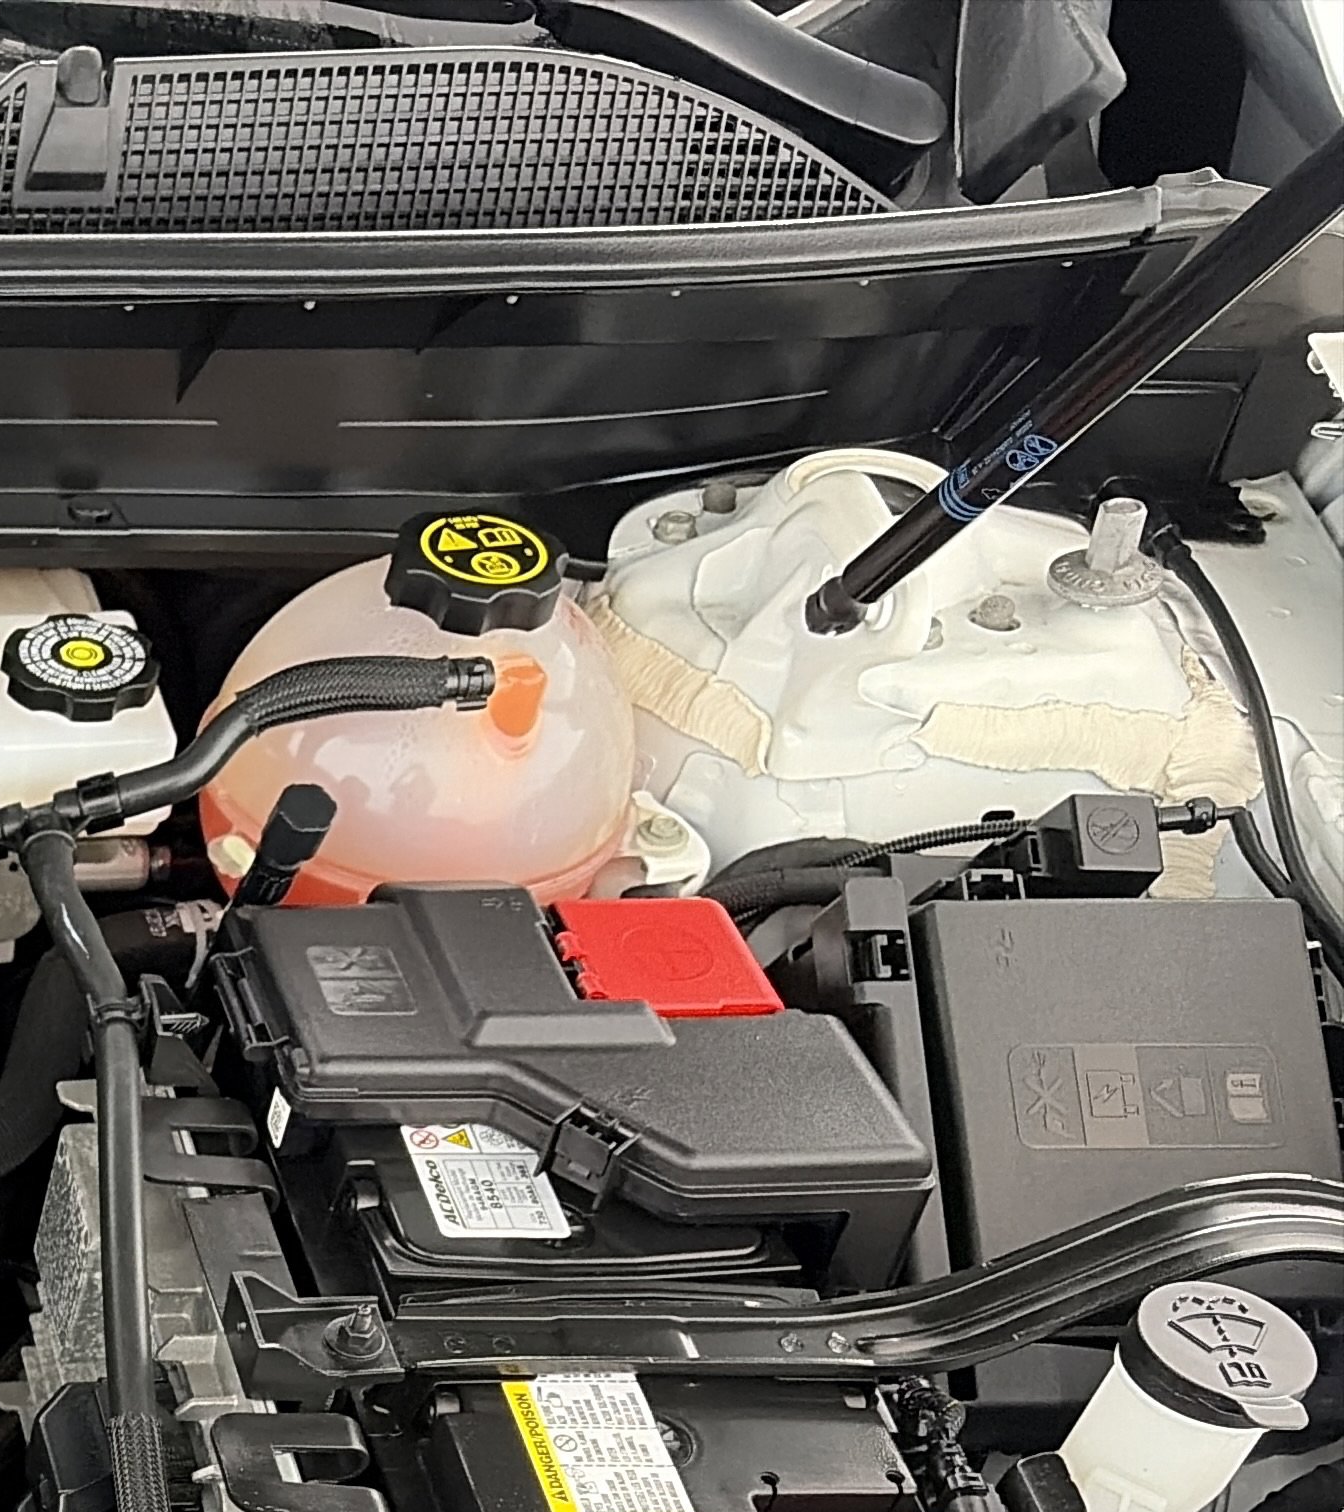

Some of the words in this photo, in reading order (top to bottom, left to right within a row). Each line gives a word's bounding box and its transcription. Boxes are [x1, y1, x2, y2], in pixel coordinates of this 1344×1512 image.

[425, 1160, 460, 1226] ACDelco
[481, 1180, 503, 1209] 8540
[513, 1392, 562, 1489] DANGER/POISON
